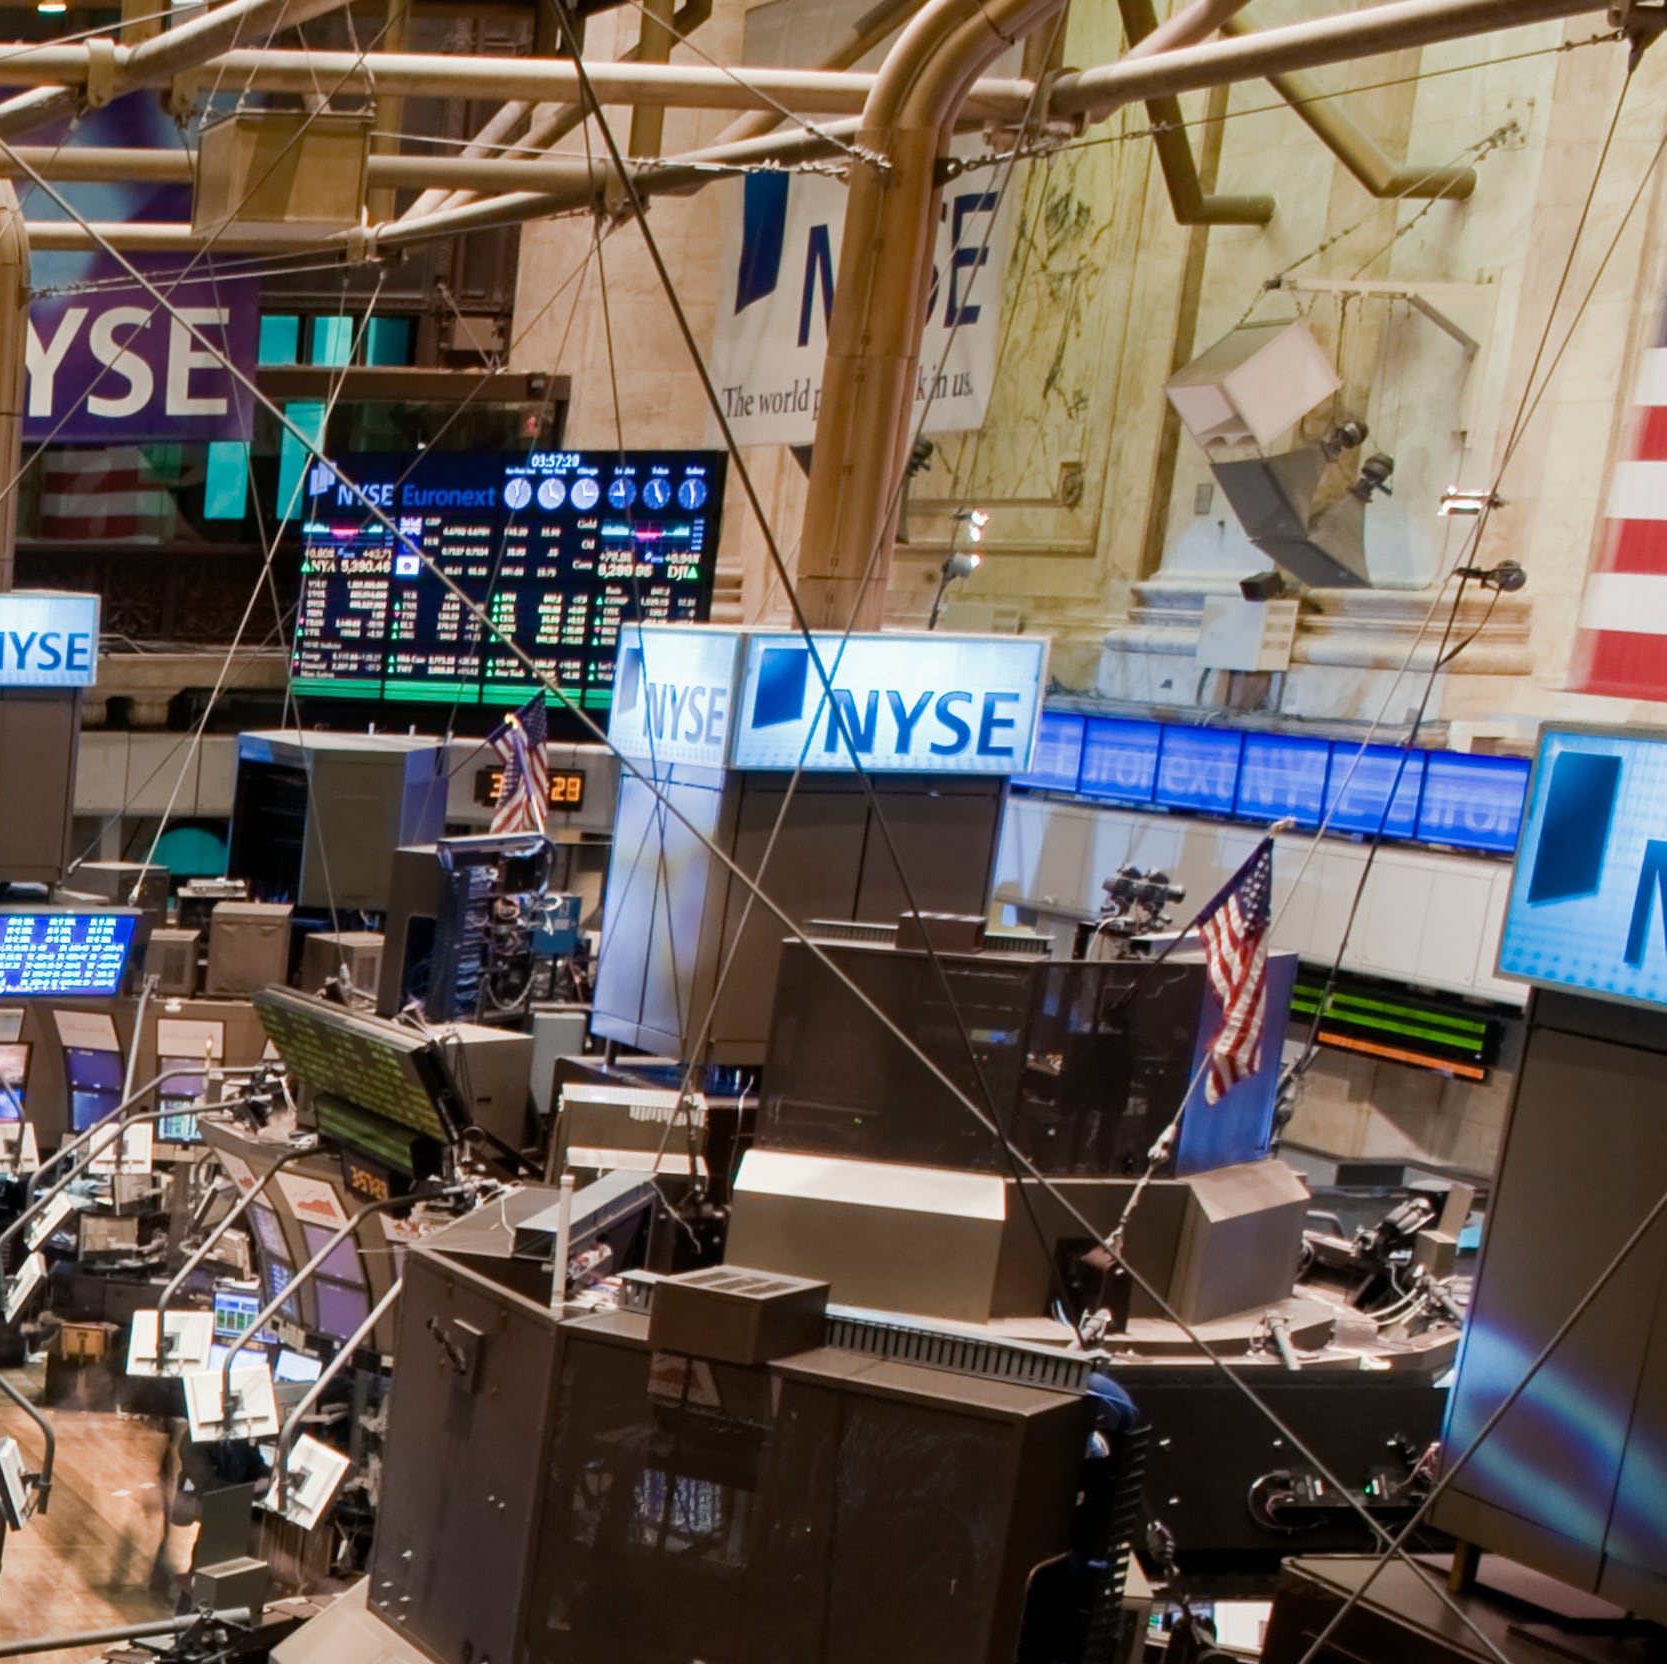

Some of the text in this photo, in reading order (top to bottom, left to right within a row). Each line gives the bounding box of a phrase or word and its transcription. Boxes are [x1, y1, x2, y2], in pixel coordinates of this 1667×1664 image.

[798, 193, 998, 348] NE
[722, 386, 754, 419] The
[759, 378, 810, 414] world
[338, 484, 497, 507] NYSE Euronext
[642, 682, 729, 746] NYSE
[825, 690, 1020, 757] NYSE
